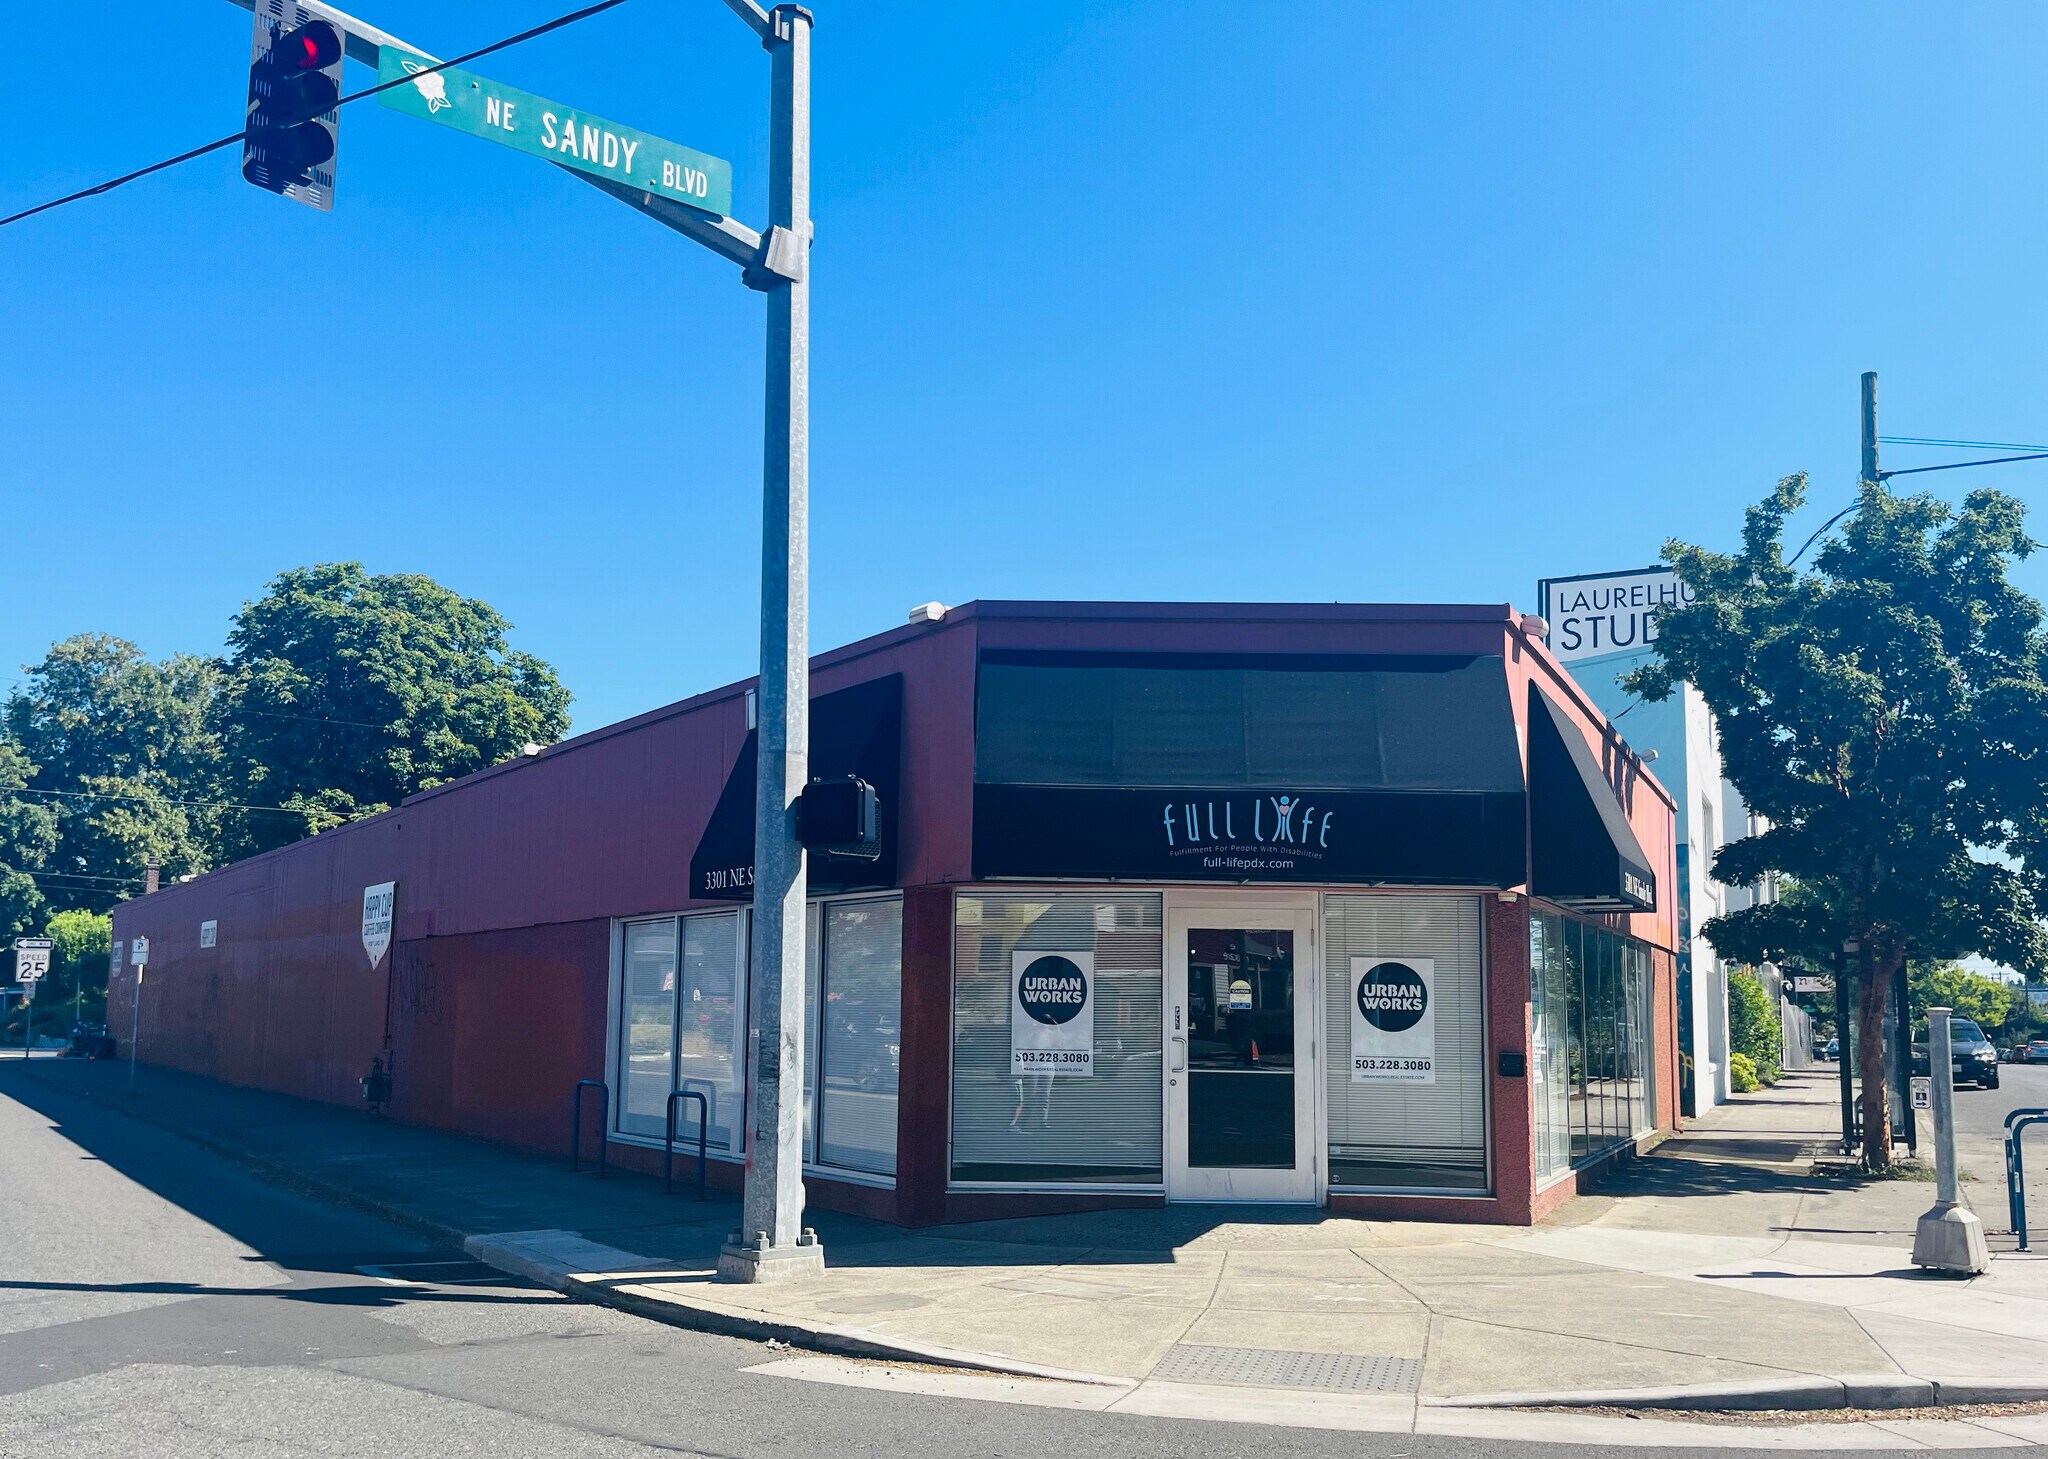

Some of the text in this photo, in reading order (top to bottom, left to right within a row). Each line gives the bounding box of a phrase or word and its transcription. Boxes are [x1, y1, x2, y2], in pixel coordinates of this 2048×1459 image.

[486, 97, 707, 198] NE SANDY BLVD
[1169, 846, 1212, 857] Fulfillment
[1230, 844, 1258, 853] People
[1260, 845, 1278, 853] With
[1280, 846, 1323, 860] Disabilities
[1203, 857, 1294, 870] full-lifepdx.com
[705, 870, 727, 890] 3301
[730, 867, 746, 887] NE
[20, 953, 48, 961] SPEED
[20, 961, 45, 980] 25
[1025, 977, 1081, 990] URBAN
[1364, 983, 1421, 997] URBAN
[1023, 990, 1082, 1003] WORKS
[1363, 997, 1423, 1010] WORKS
[1015, 1052, 1089, 1063] 503.228.3080
[1355, 1060, 1431, 1070] 503.228.3080
